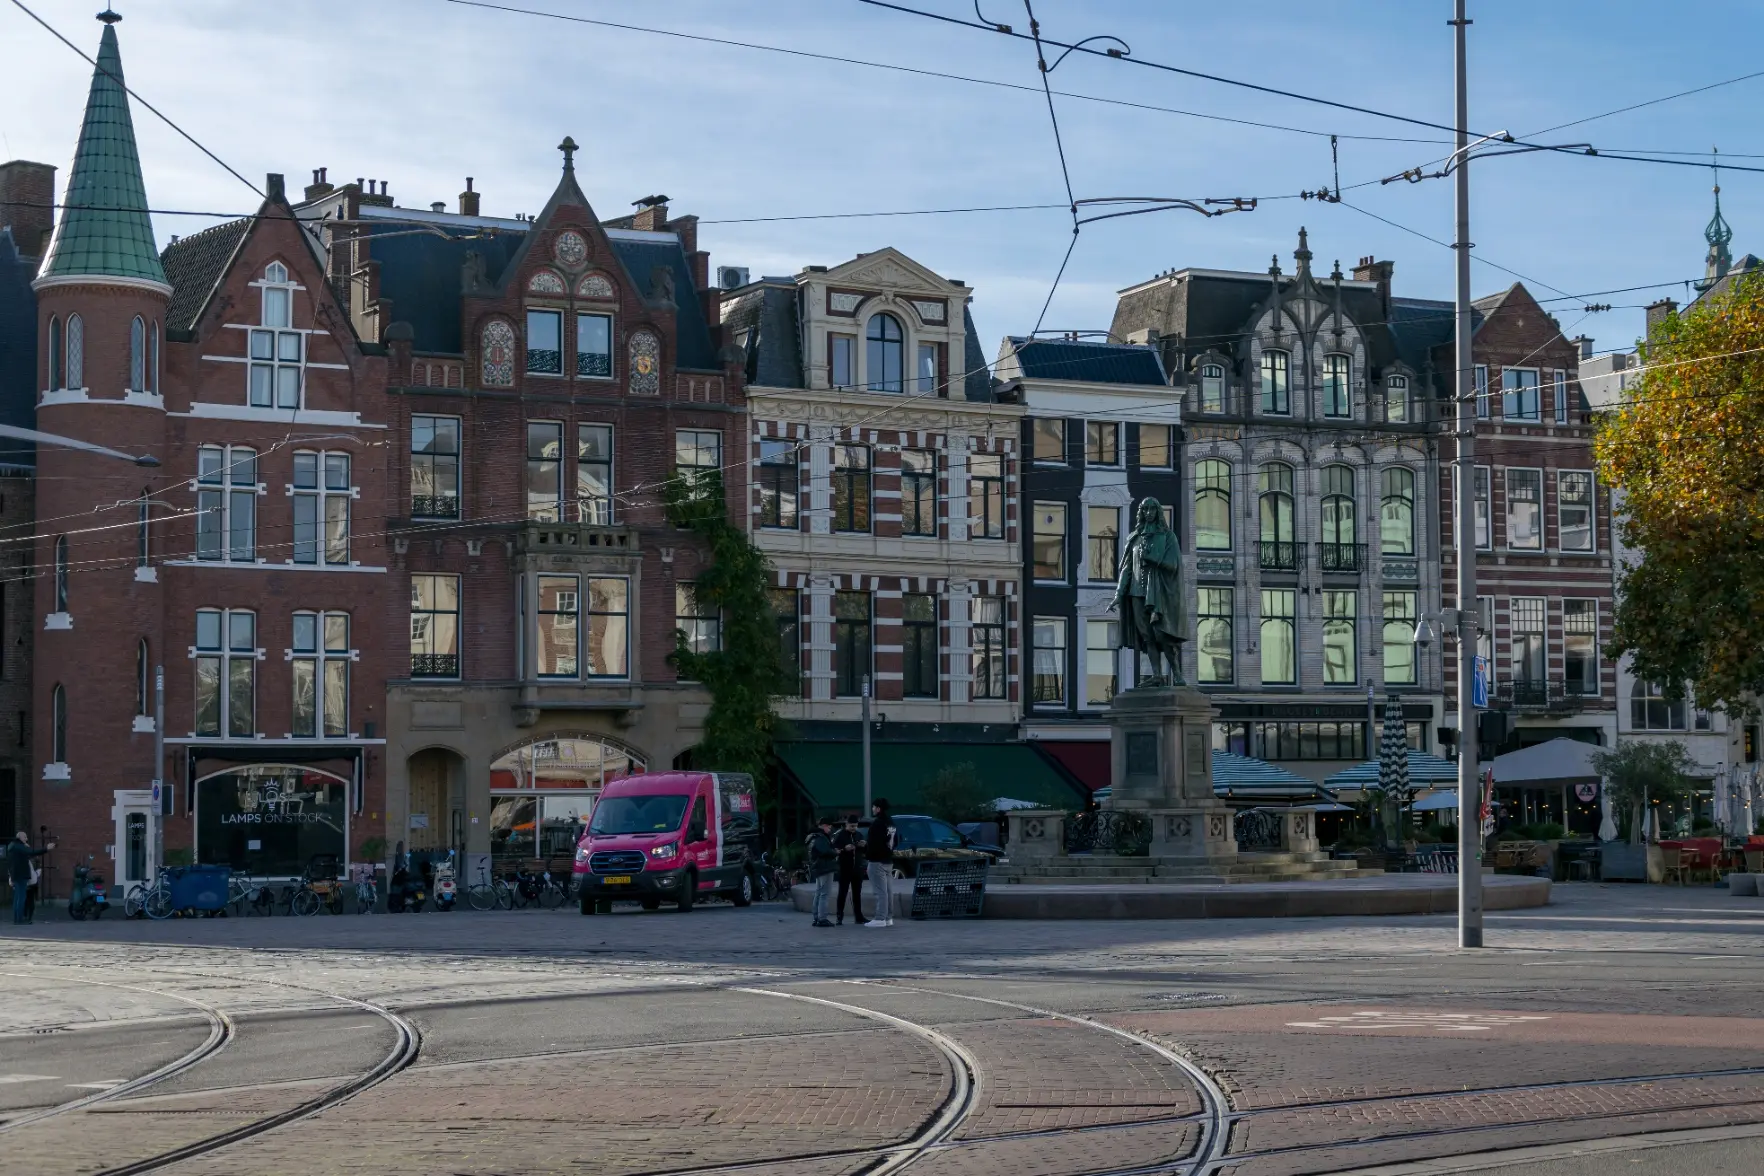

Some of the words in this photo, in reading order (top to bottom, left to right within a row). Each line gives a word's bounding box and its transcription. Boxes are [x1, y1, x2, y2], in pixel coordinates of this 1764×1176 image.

[221, 813, 262, 824] LAMPS
[264, 813, 283, 824] ON
[286, 812, 323, 823] STOCK
